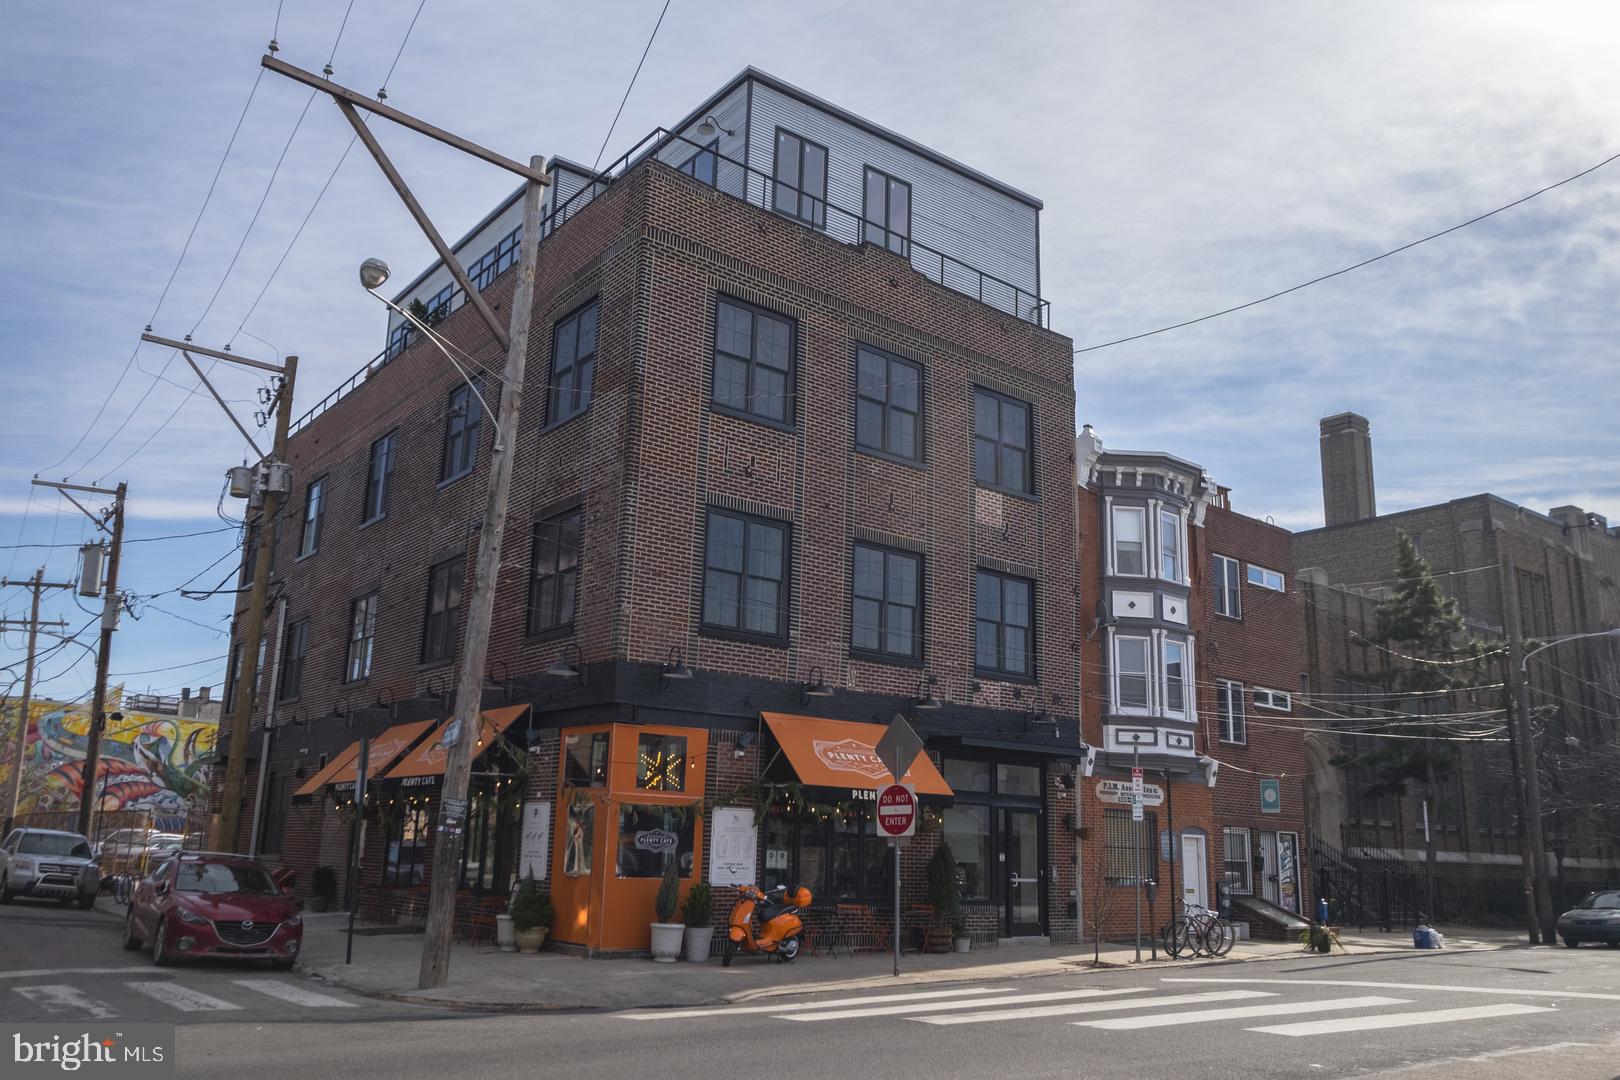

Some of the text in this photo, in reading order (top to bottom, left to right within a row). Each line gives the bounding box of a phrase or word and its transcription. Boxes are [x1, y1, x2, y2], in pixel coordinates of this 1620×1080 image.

[827, 751, 867, 761] PLENTY
[401, 777, 421, 787] PLENTY
[852, 789, 878, 800] PLEN
[883, 794, 909, 804] DO NOT
[885, 816, 907, 826] ENTER
